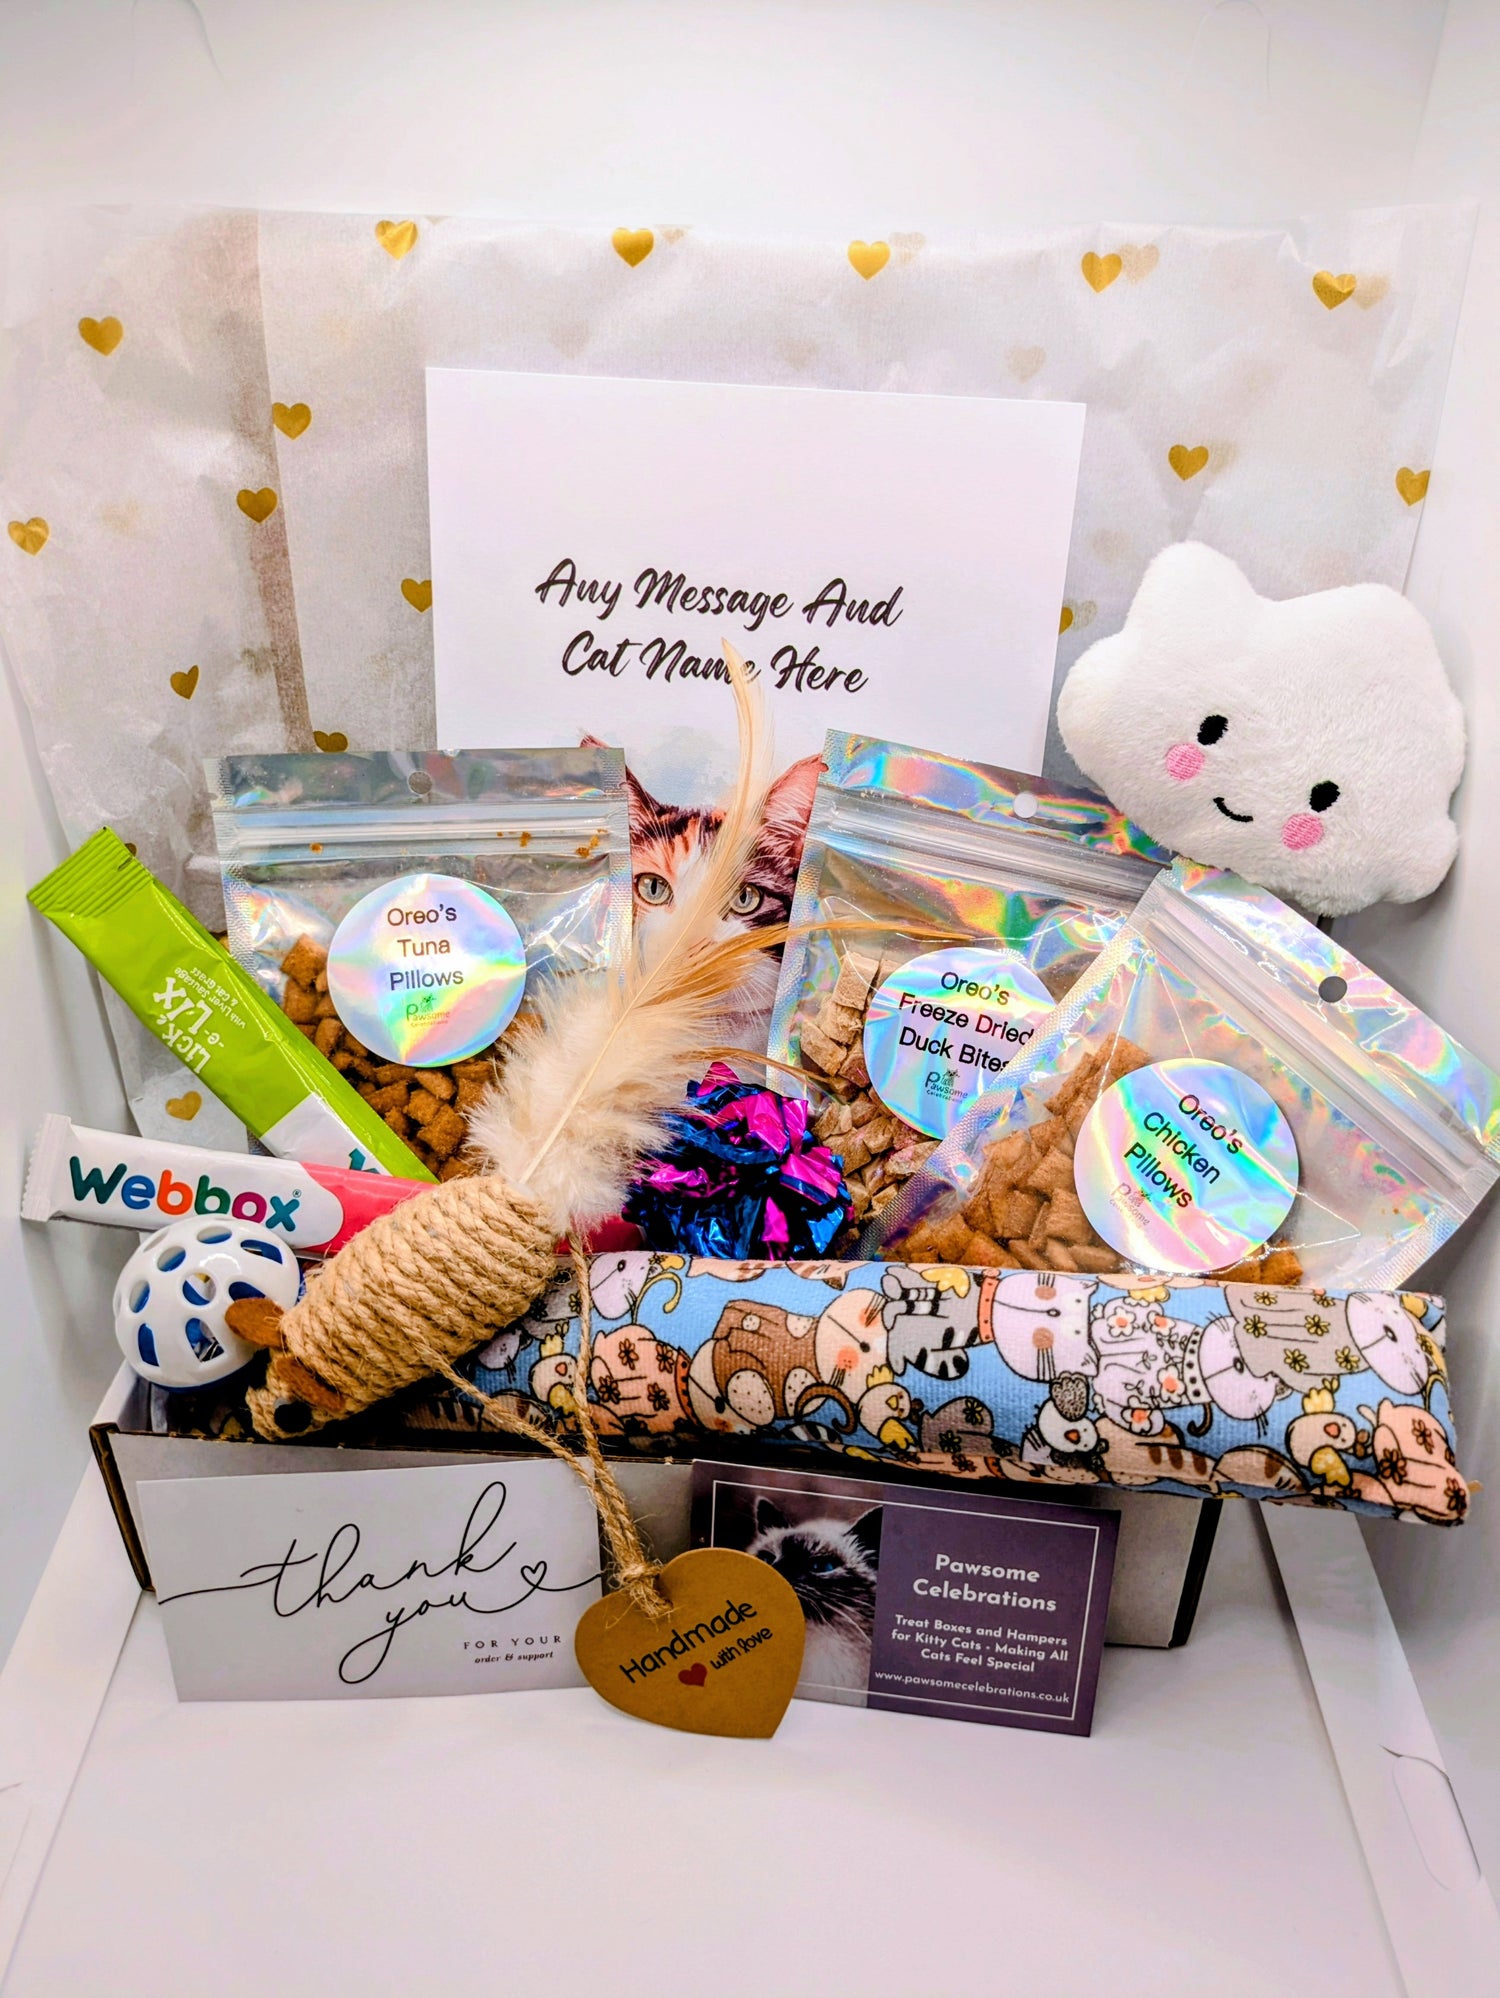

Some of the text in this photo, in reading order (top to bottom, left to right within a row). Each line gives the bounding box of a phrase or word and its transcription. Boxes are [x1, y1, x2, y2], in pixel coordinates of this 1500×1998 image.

[535, 558, 904, 631] Any Message And
[562, 631, 868, 694] Cat Name Here
[387, 904, 457, 926] Oreo's
[397, 938, 450, 957] Tuna
[175, 967, 210, 998] Sausage
[190, 967, 216, 989] Grass
[390, 970, 464, 991] Pillows
[941, 972, 1010, 1005] Oreo's
[209, 995, 232, 1017] Liver
[899, 993, 1034, 1045] Freeze Dried
[899, 1026, 954, 1059] Duck
[925, 1072, 968, 1098] Pawsome
[1178, 1094, 1243, 1155] Oreo's
[1143, 1112, 1221, 1184] Chicken
[1124, 1142, 1193, 1208] Pillows
[159, 1482, 516, 1616] thank
[935, 1553, 1040, 1583] Pawsome
[913, 1579, 1057, 1612] Celebrations
[339, 1587, 512, 1684] you
[463, 1635, 561, 1649] FOR YOUR
[619, 1599, 758, 1684] Handmade
[891, 1628, 910, 1641] for
[915, 1632, 947, 1648] Kitty
[951, 1637, 981, 1651] Cats
[995, 1643, 1045, 1661] Making
[1050, 1650, 1068, 1661] All
[895, 1614, 1068, 1647] Treat Boxes and Hampers
[475, 1654, 500, 1663] order
[518, 1651, 554, 1662] support
[710, 1627, 773, 1670] with love
[920, 1649, 1035, 1672] Cats Feel Special
[874, 1670, 1070, 1704] www.pawsomecelebrations.co.uk
